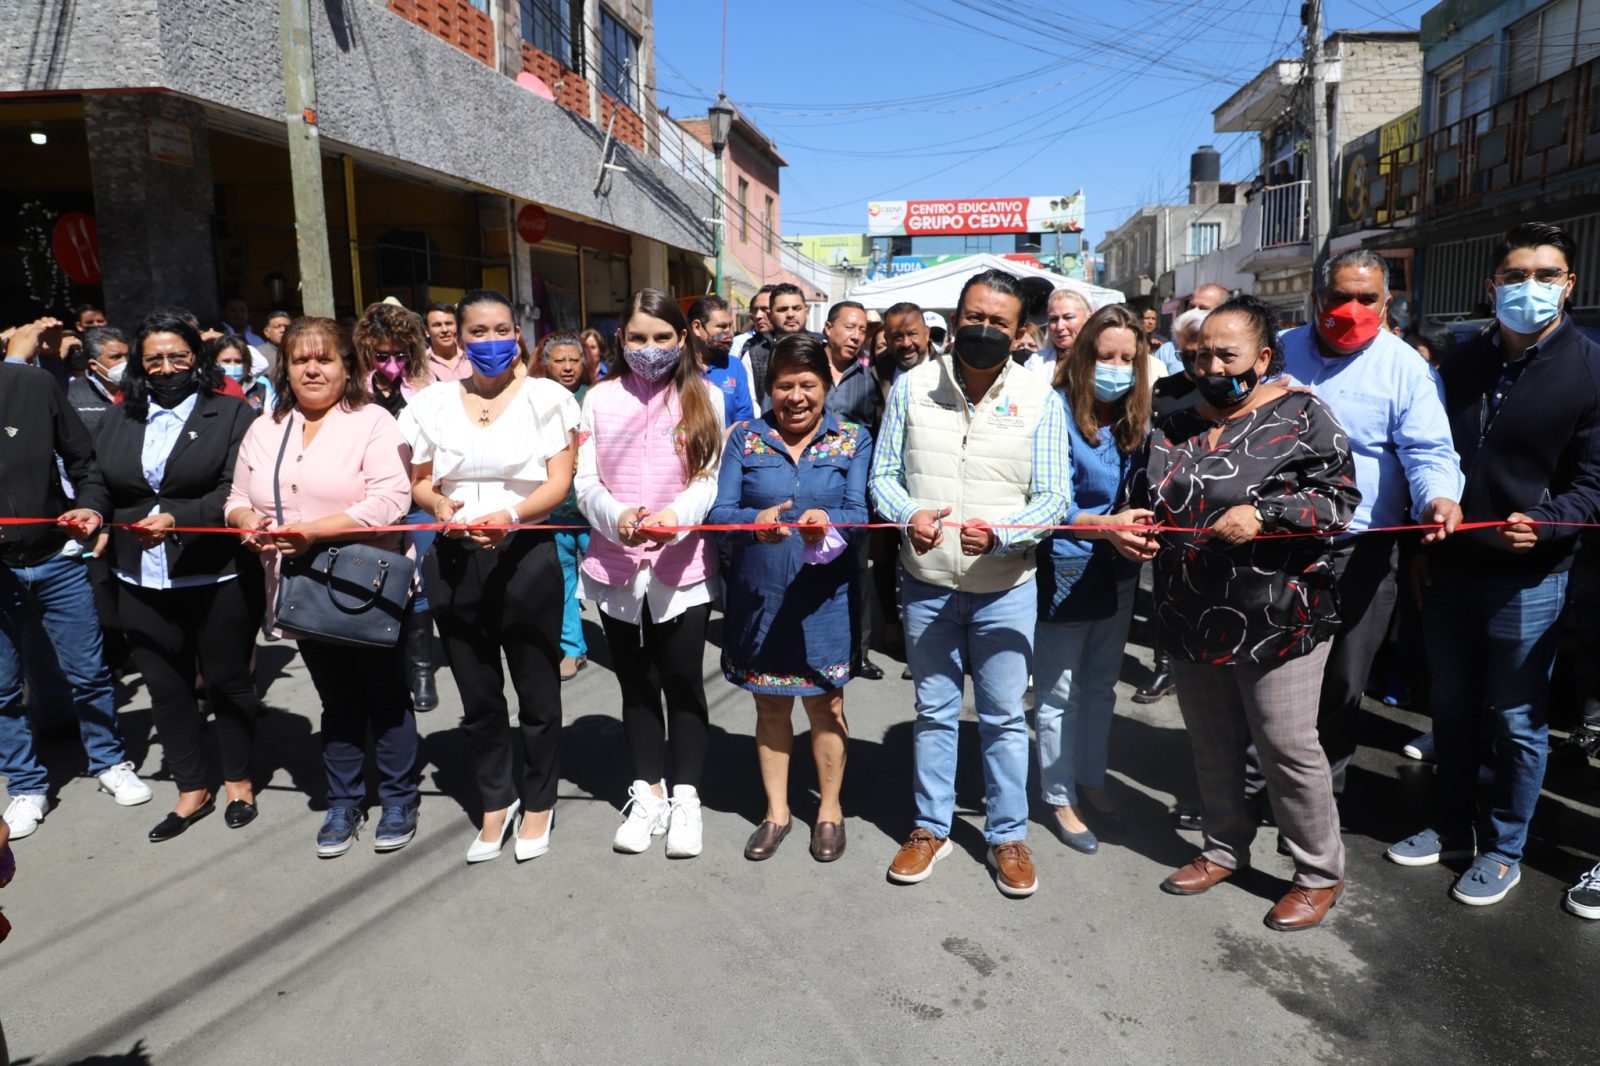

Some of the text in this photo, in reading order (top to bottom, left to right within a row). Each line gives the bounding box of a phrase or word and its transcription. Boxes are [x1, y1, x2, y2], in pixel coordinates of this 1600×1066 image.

[910, 201, 1023, 215] CENTRO EDUCATIVO
[908, 213, 1025, 230] GRUPO CEDVA
